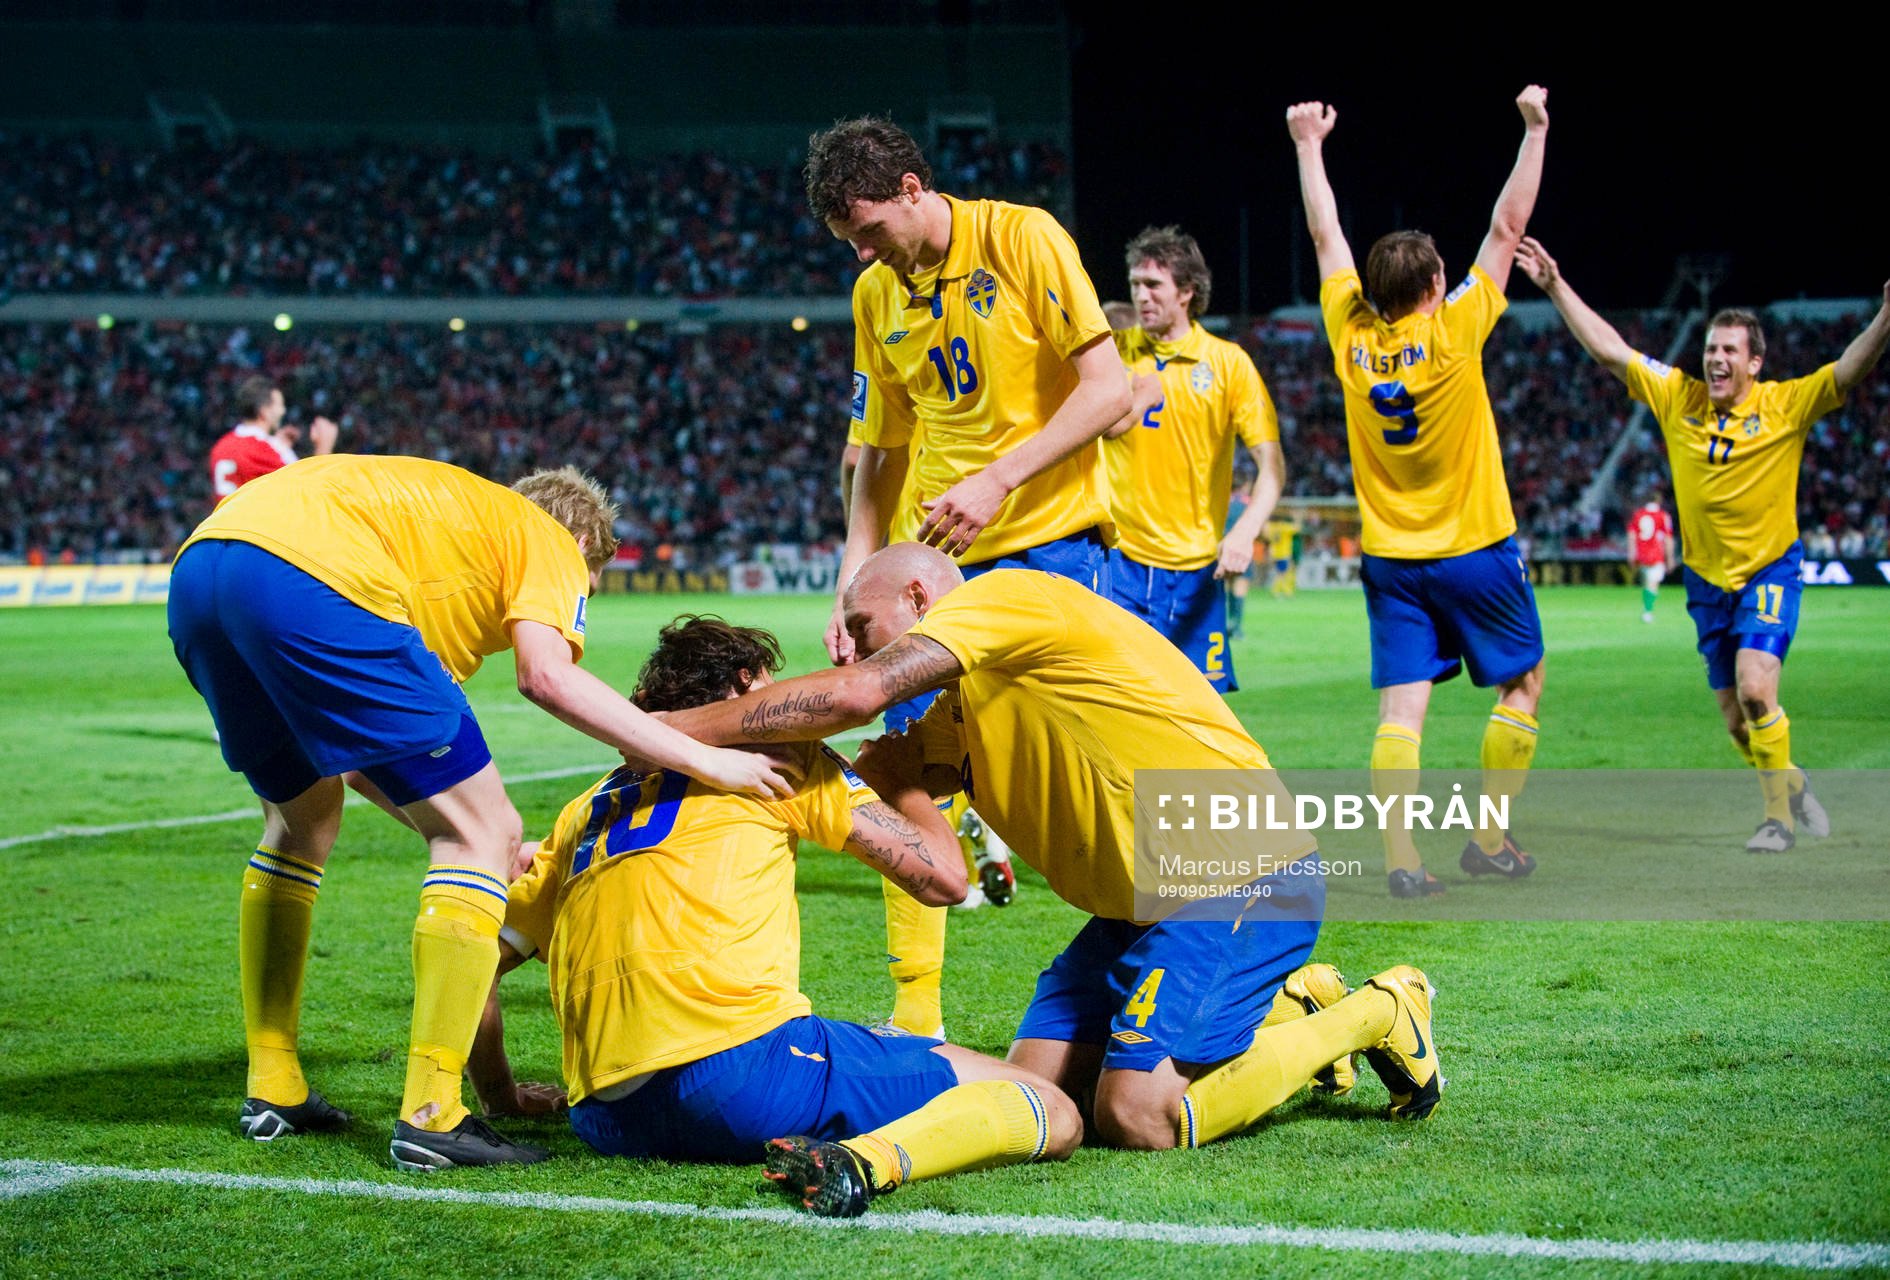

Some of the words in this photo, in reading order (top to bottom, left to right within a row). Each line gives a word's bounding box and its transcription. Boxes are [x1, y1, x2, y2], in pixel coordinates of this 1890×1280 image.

[928, 336, 978, 402] 18
[1369, 380, 1419, 445] 9
[1709, 435, 1735, 465] 17
[1639, 515, 1655, 540] 9
[1756, 584, 1784, 617] 17
[1207, 632, 1224, 671] 2
[742, 691, 834, 731] Madeleine
[1125, 968, 1165, 1027] 4
